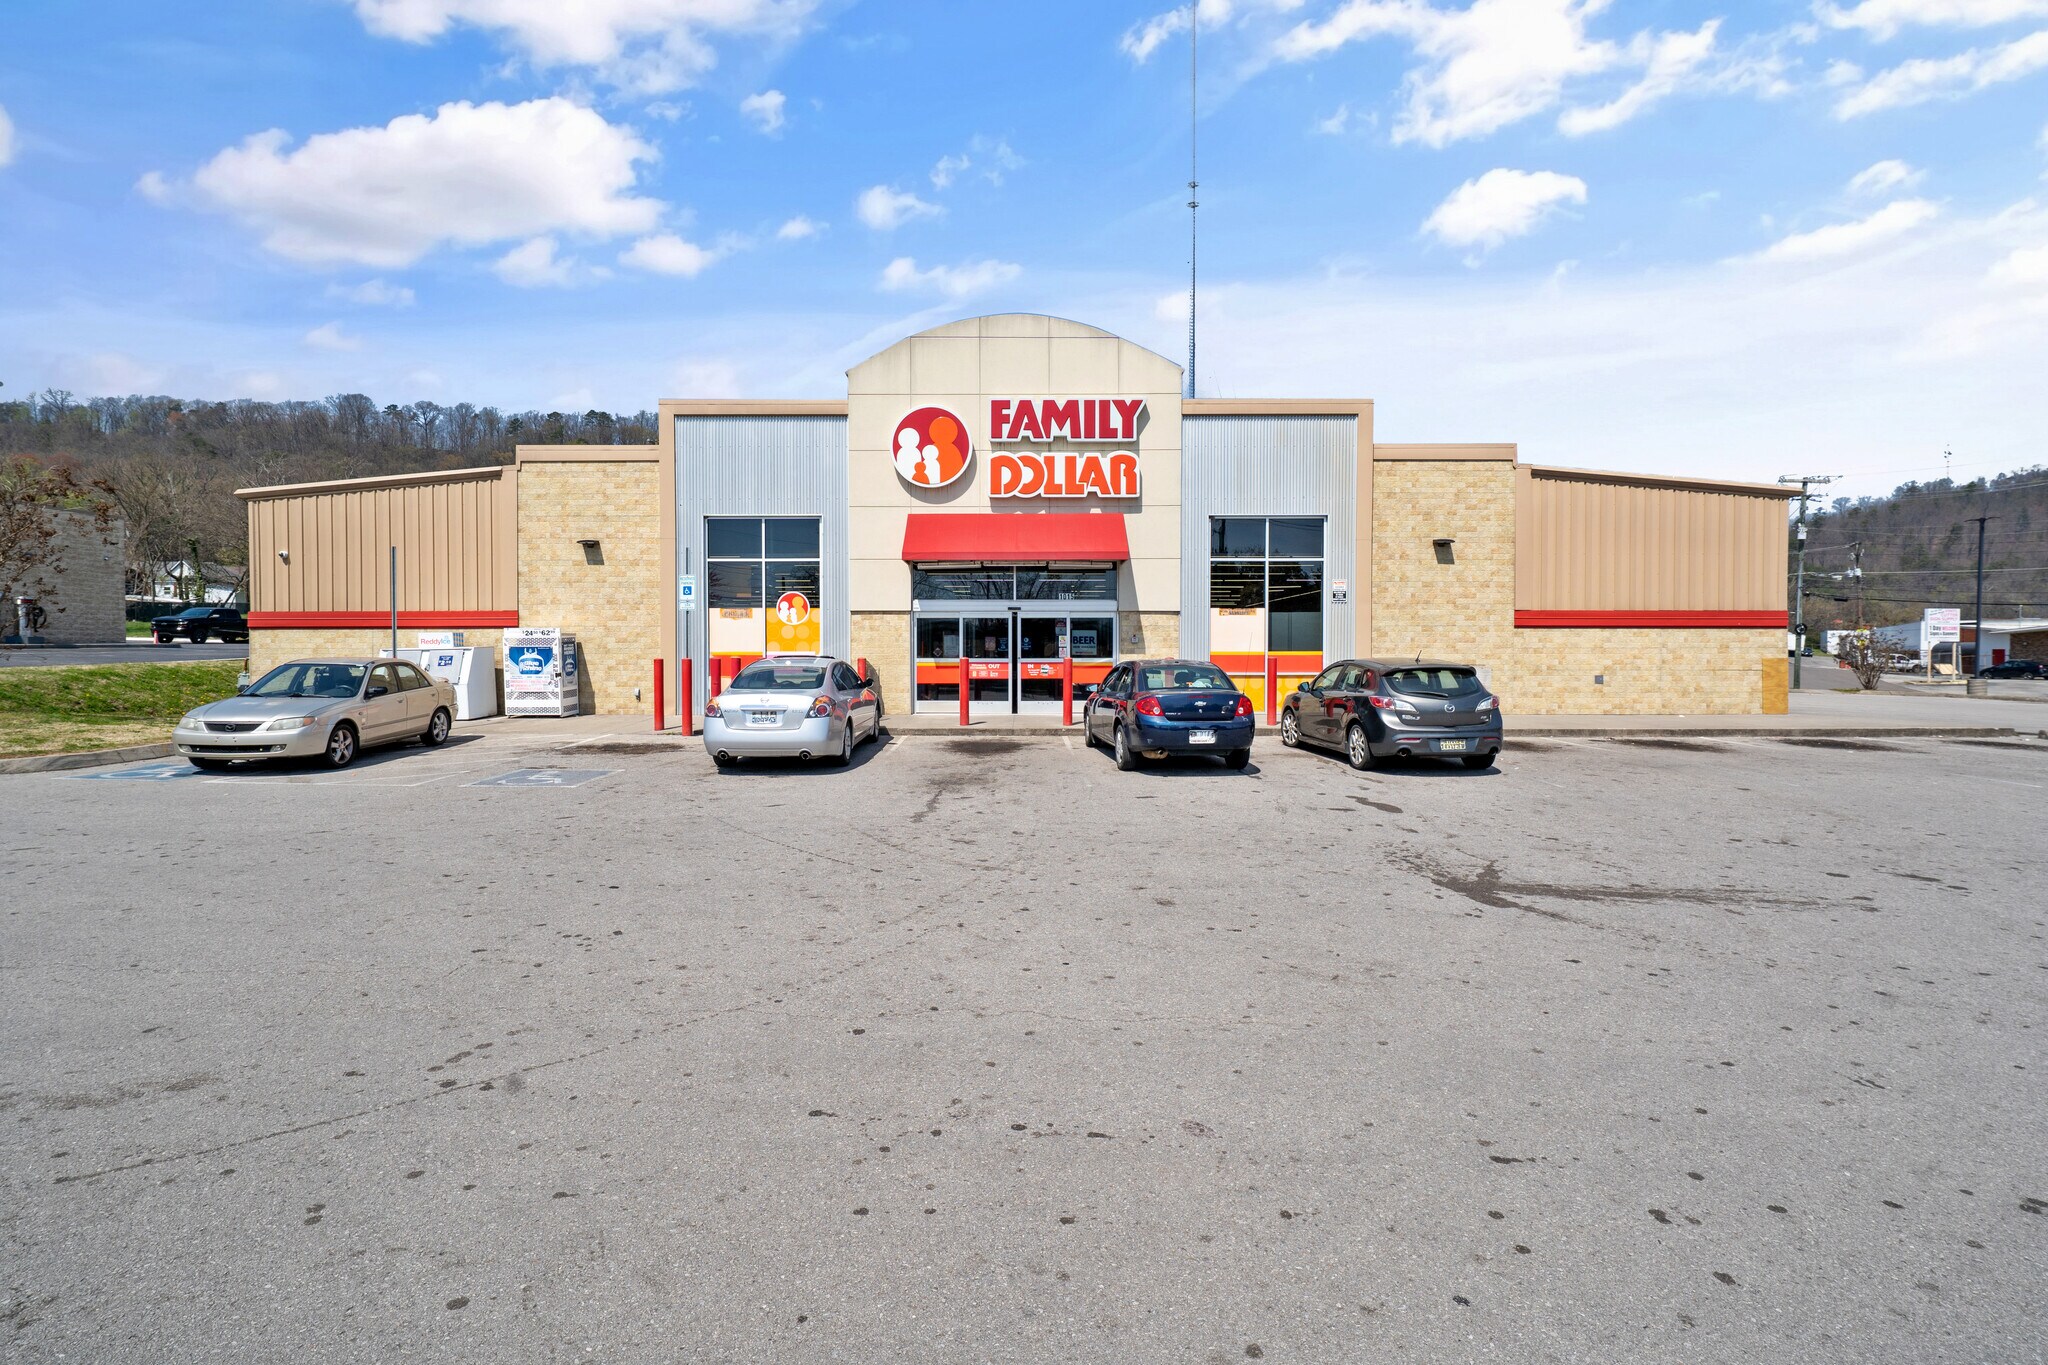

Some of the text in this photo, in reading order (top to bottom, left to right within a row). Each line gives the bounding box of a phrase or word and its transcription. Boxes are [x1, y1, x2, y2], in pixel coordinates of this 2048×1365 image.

[990, 399, 1144, 439] FAMILY
[990, 454, 1138, 495] DOLLAR
[1073, 636, 1096, 645] BEER
